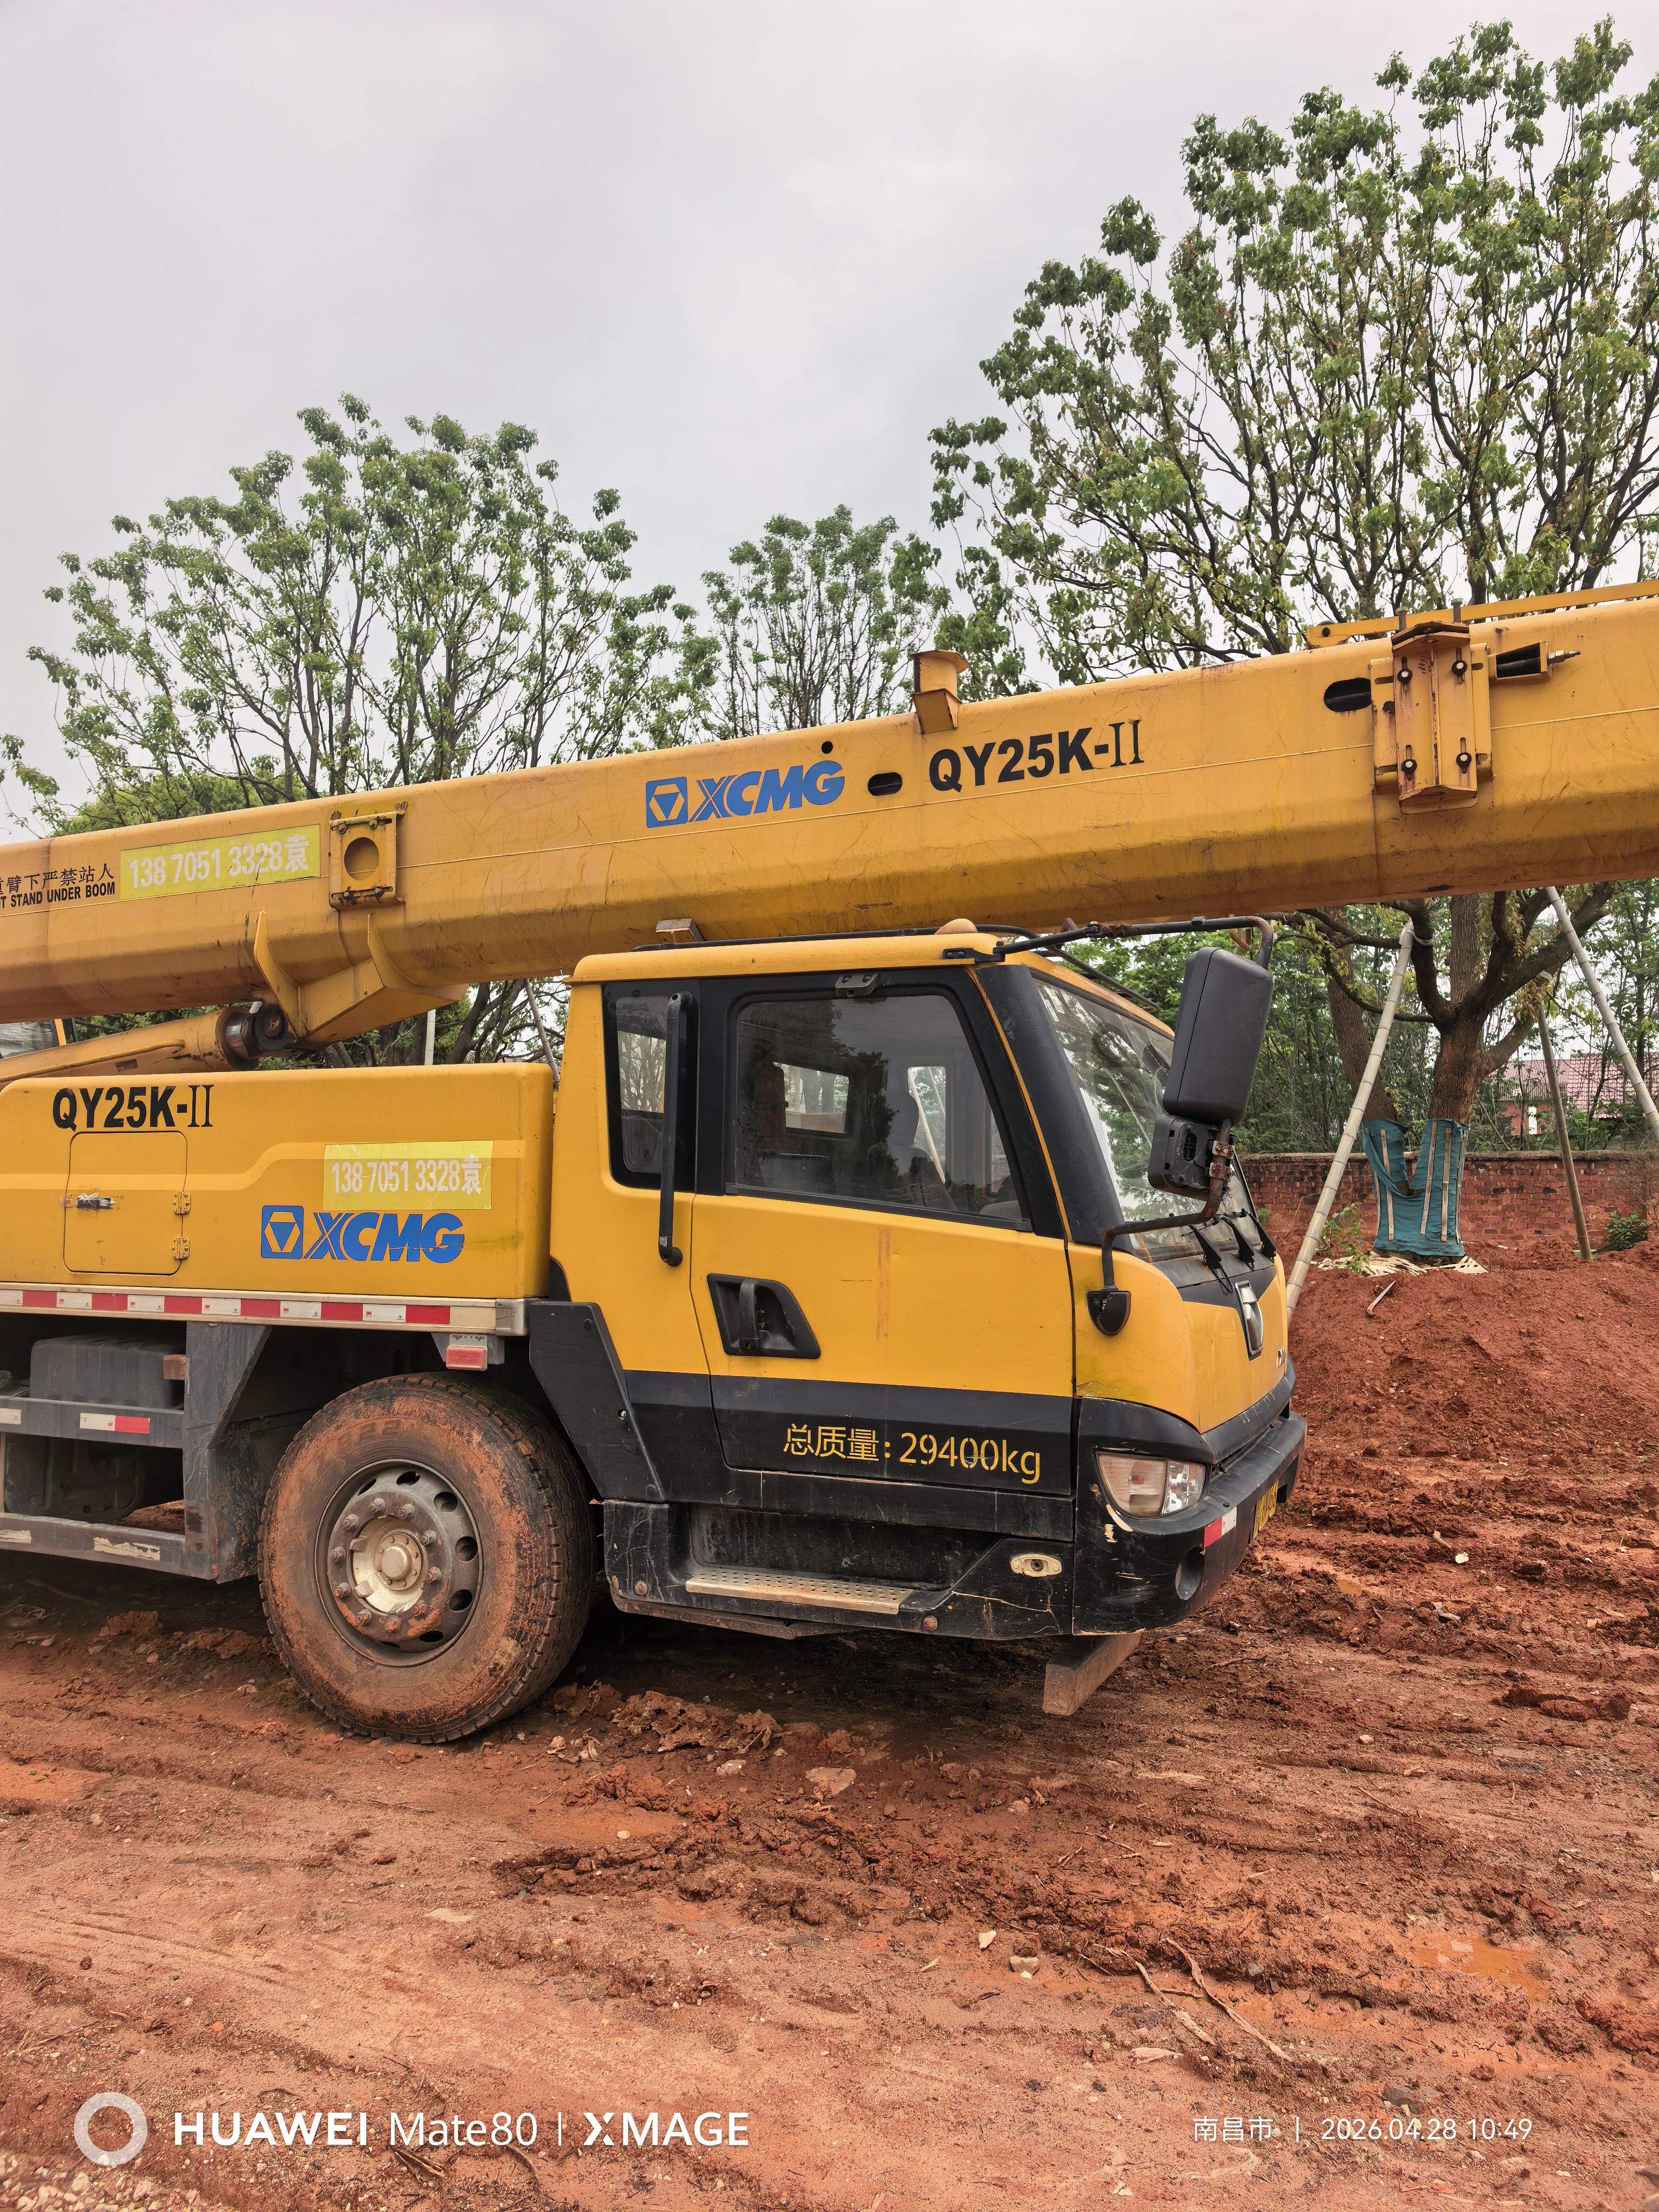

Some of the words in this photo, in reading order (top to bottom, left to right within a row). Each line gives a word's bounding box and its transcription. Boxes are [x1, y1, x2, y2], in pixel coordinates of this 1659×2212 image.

[689, 759, 845, 822] XCMG
[0, 863, 115, 894] 臂下严禁站人
[129, 856, 166, 888] 138
[171, 848, 221, 884] 7051
[11, 891, 43, 907] STAND
[47, 886, 81, 903] UNDER
[85, 881, 115, 898] BOOM
[332, 1162, 363, 1192] 138
[367, 1161, 409, 1192] 7051
[305, 1211, 465, 1263] XCMG
